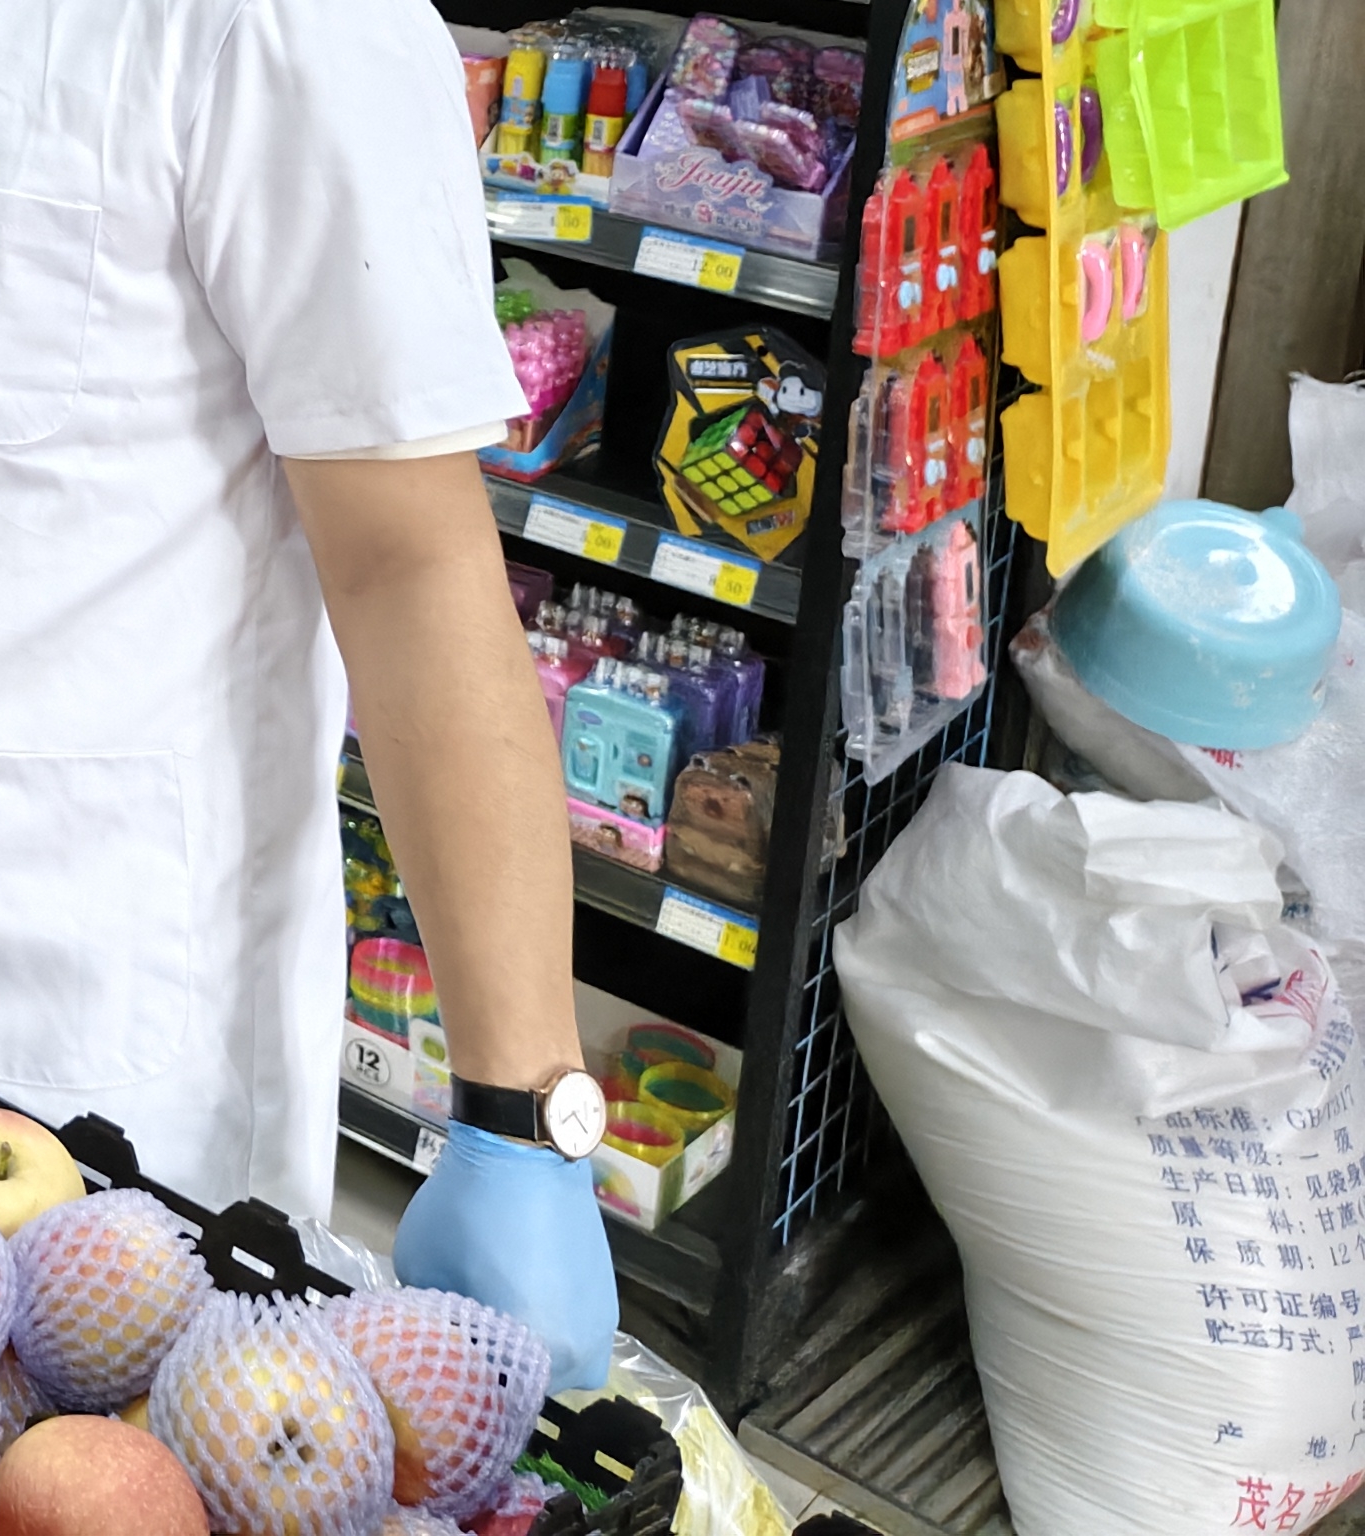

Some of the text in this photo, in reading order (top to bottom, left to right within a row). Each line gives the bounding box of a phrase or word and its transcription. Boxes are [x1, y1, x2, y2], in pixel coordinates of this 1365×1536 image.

[354, 1047, 382, 1072] 12
[1195, 1283, 1361, 1320] 许可证编号
